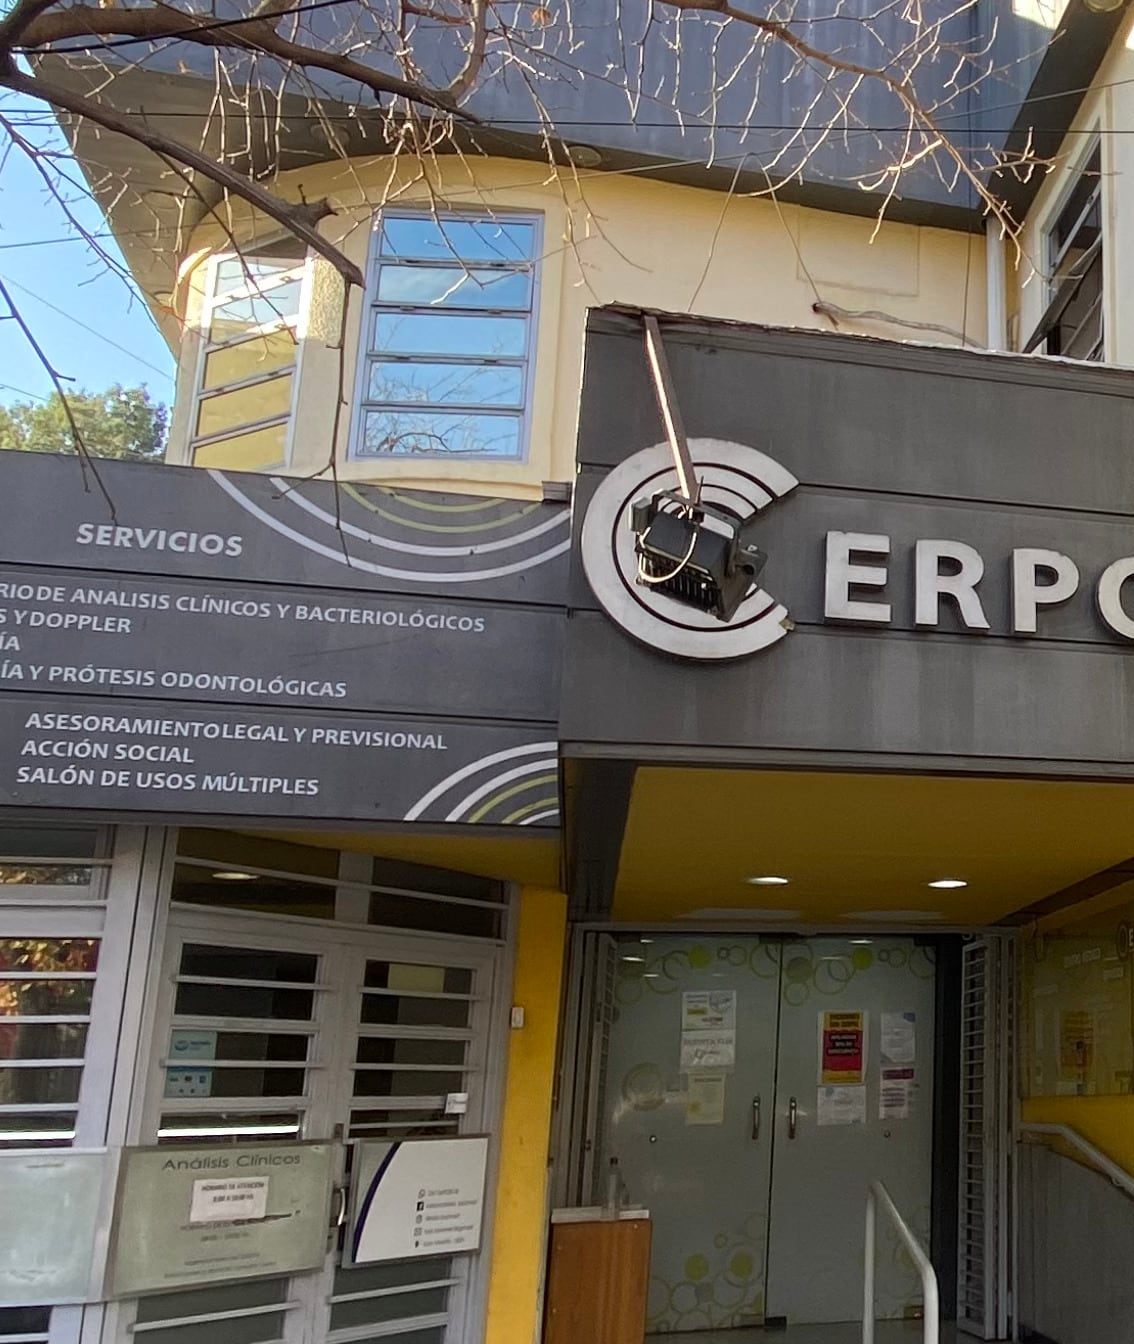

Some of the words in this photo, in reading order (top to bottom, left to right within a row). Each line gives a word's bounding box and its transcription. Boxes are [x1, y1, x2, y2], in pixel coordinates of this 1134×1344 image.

[76, 523, 243, 557] SERVICIOS
[13, 609, 28, 625] Y
[29, 611, 132, 634] DOPPLER
[36, 586, 66, 603] DE
[70, 588, 170, 610] ANALISIS
[176, 594, 271, 618] CLÍNICOS
[277, 604, 291, 619] Y
[295, 605, 485, 633] BACTERIOLÓGICOS
[29, 664, 44, 680] Y
[48, 663, 156, 687] PRÓTESIS
[161, 670, 348, 698] ODONTOLÓGICAS
[25, 712, 220, 740] ASESORAMIENTO
[221, 723, 289, 743] LEGAL
[293, 727, 307, 743] Y
[311, 728, 447, 750] PREVISIONAL
[21, 738, 109, 759] ACCIÓN
[114, 742, 195, 764] SOCIAL
[16, 764, 95, 786] SALÓN
[100, 769, 131, 788] DE
[136, 772, 196, 791] USOS
[201, 772, 319, 796] MÚLTIPLES
[162, 1156, 229, 1172] Análisis
[236, 1153, 301, 1168] Clínicos
